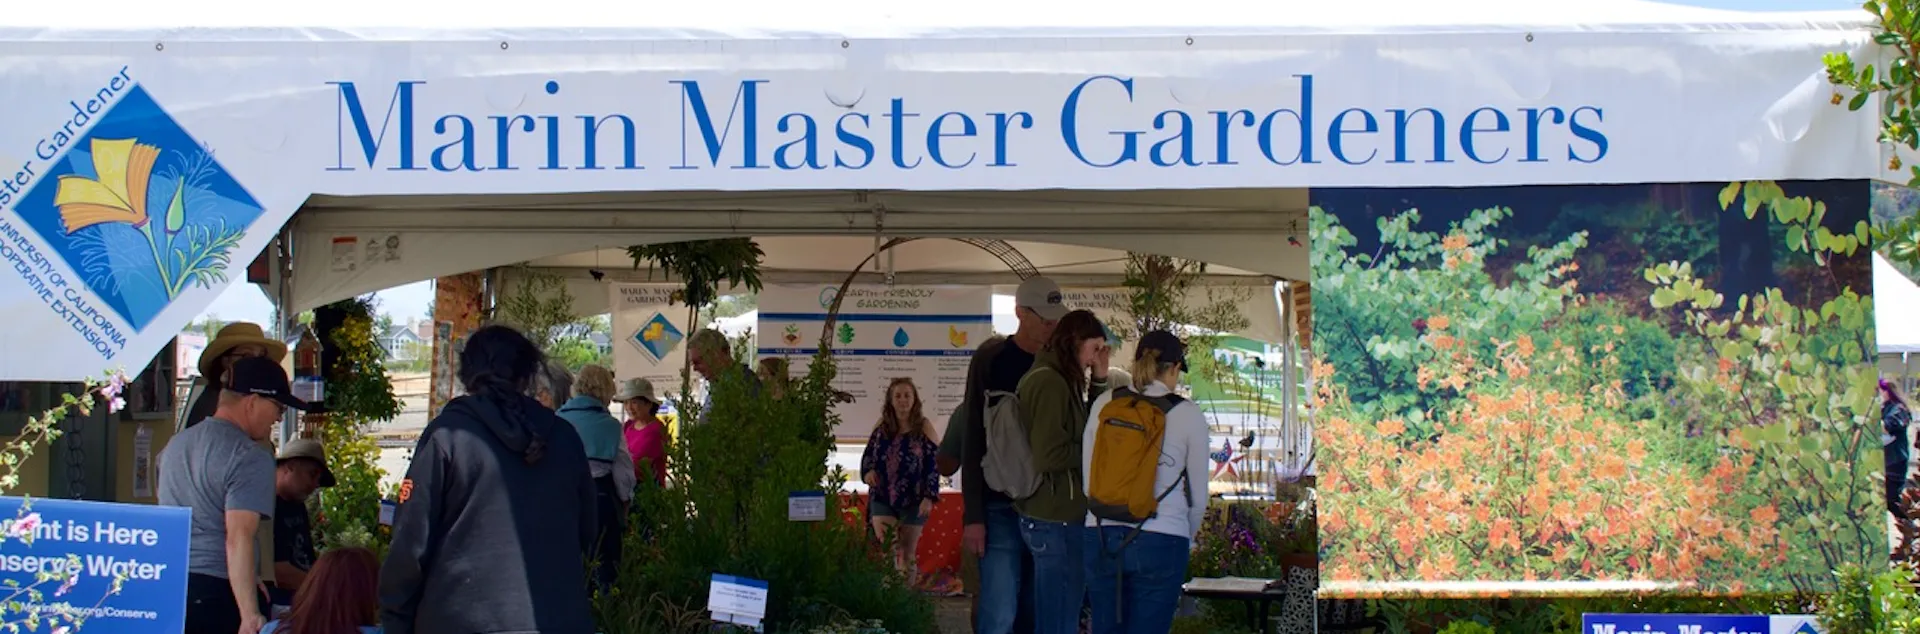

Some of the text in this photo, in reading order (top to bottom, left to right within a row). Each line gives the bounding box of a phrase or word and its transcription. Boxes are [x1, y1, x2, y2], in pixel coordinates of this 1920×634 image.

[0, 65, 131, 210] ster Gardener
[325, 74, 1609, 172] Marin Master Gardeners
[49, 271, 68, 288] OF
[64, 288, 127, 350] CALIFORNIA
[51, 299, 116, 361] EXTENSION
[856, 299, 921, 308] GARDENING
[67, 520, 89, 543] is
[95, 521, 158, 547] Here
[87, 554, 167, 580] Water
